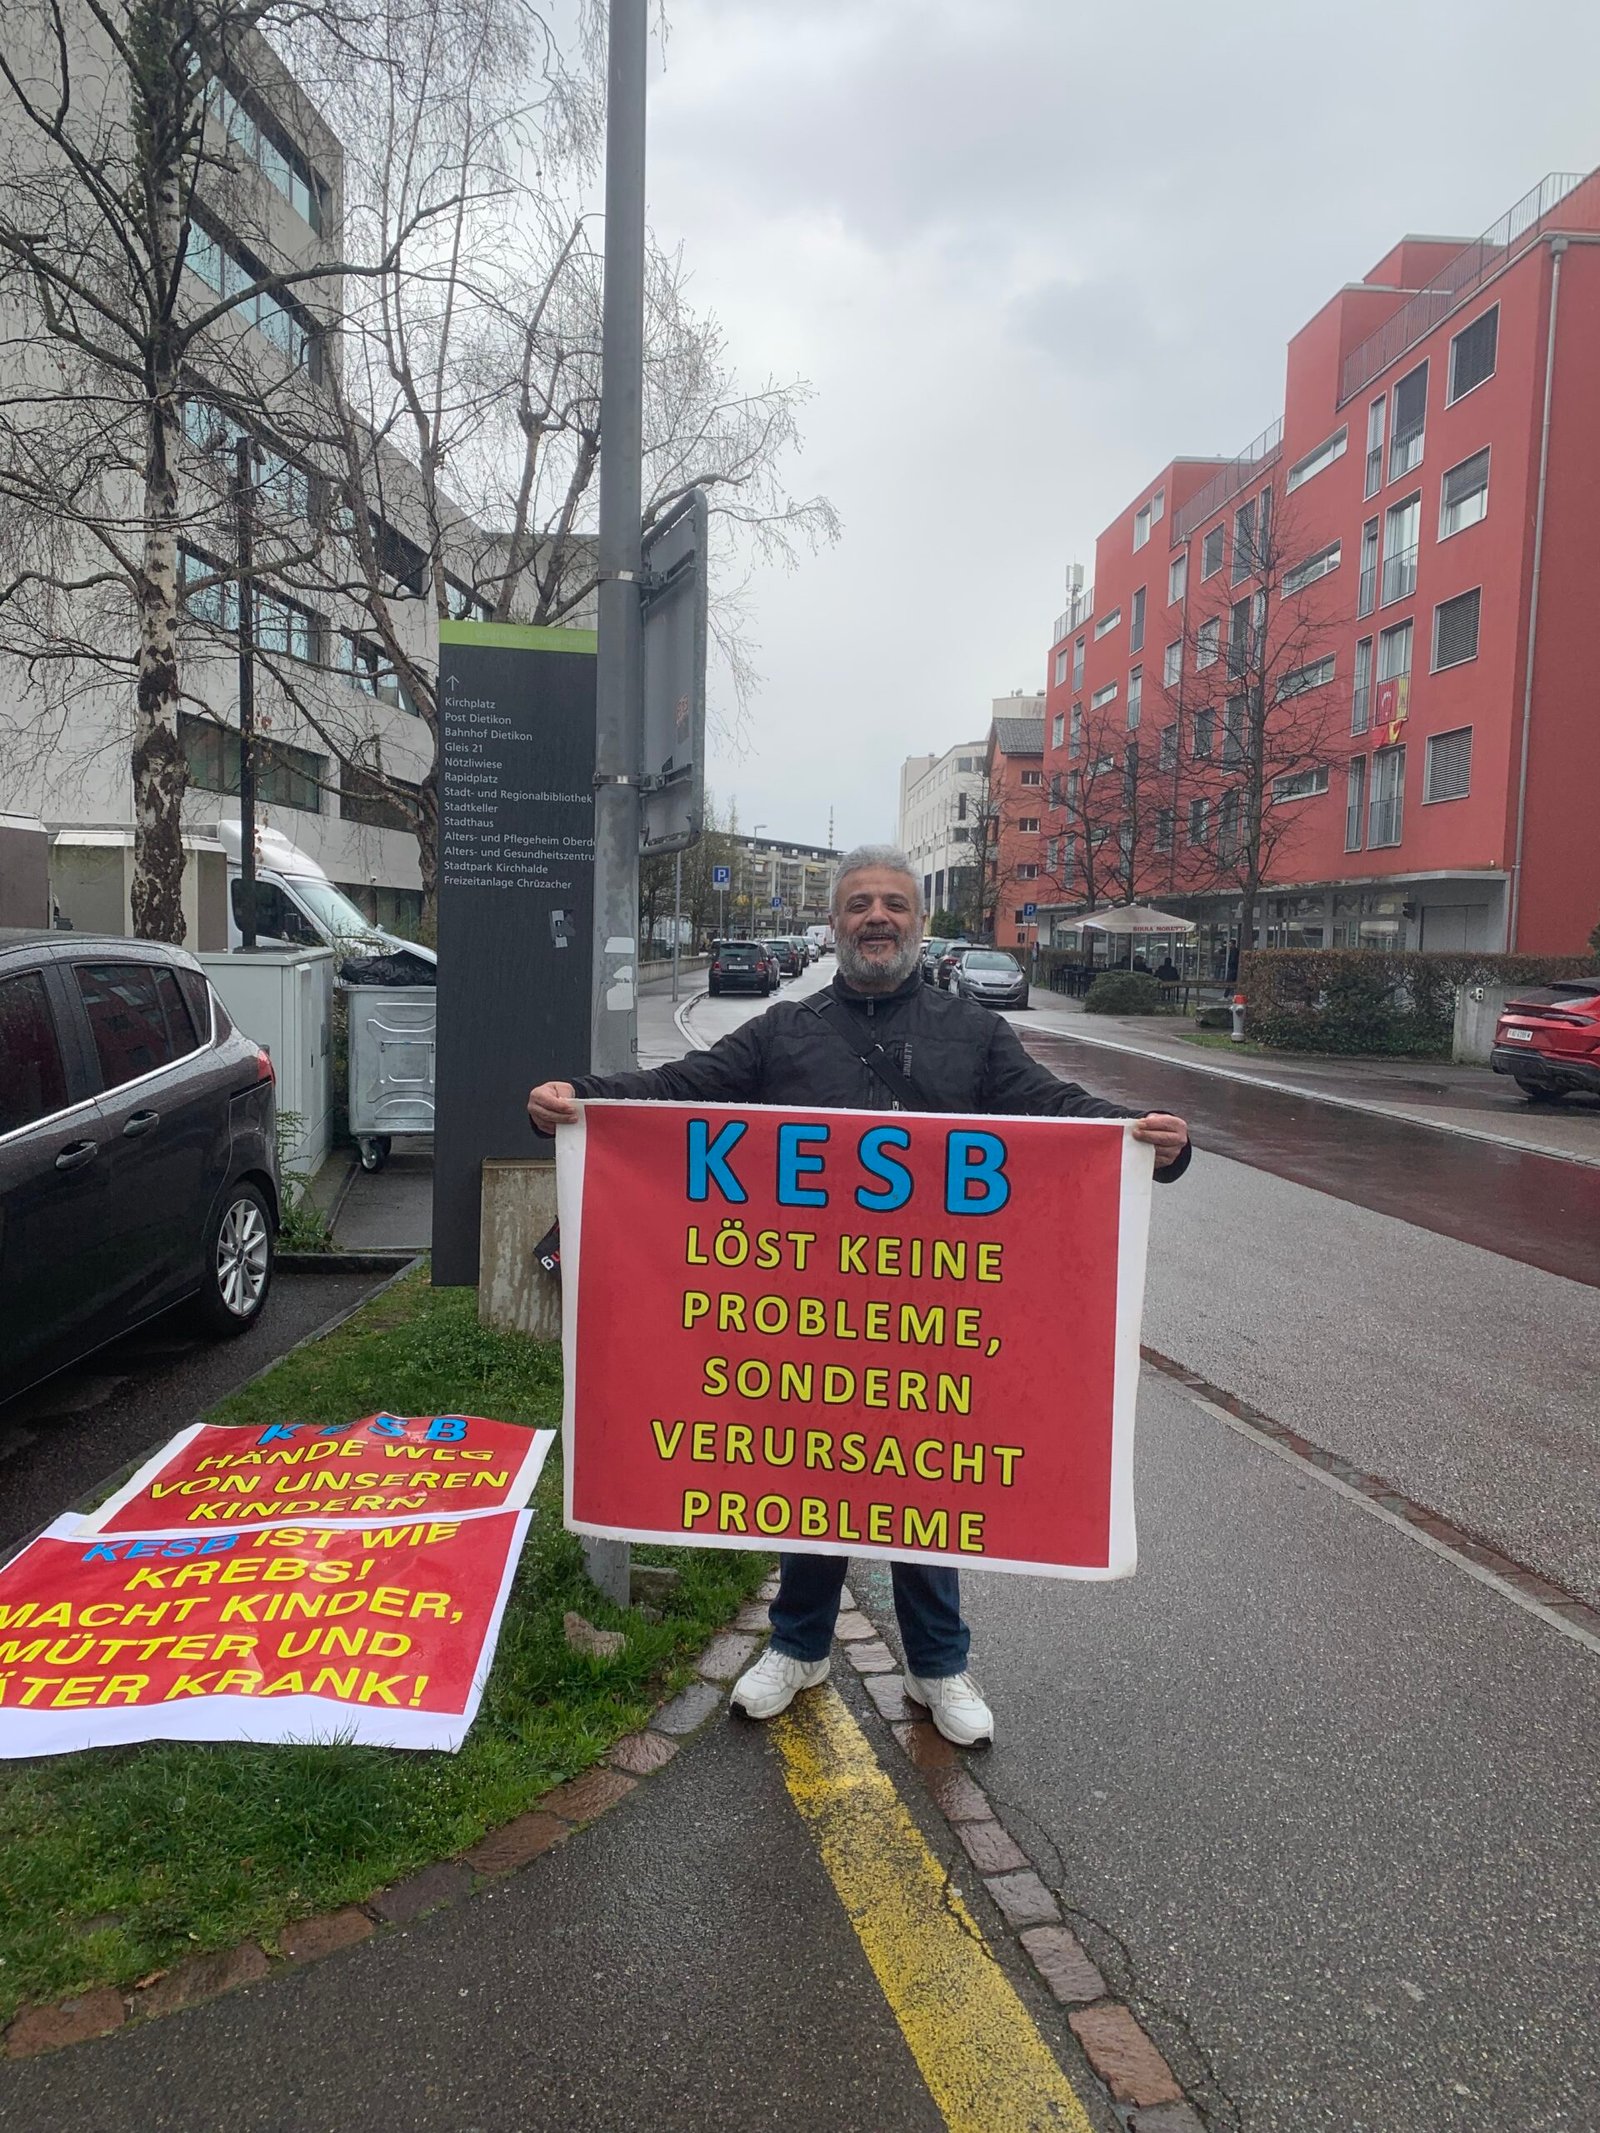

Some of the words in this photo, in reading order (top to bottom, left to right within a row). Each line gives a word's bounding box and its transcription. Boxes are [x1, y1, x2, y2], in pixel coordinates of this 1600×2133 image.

[444, 697, 496, 710] Kirchplatz
[444, 712, 466, 722] Post
[469, 713, 512, 725] Dietikon
[444, 727, 488, 739] Bahnhof
[491, 729, 533, 741] Dietikon
[444, 742, 469, 753] Gleis
[472, 744, 483, 753] 21
[444, 757, 503, 769] Nötzliwiese
[444, 772, 499, 785] Rapidplatz
[444, 787, 475, 797] Stadt-
[477, 789, 497, 798] und
[500, 790, 593, 804] Regionalbibliothek
[444, 802, 499, 813] Stadtkeller
[444, 817, 494, 828] Stadthaus
[444, 832, 478, 842] Alters-
[481, 834, 501, 843] und
[503, 834, 559, 846] Pflegeheim
[444, 846, 478, 856] Alters-
[480, 848, 500, 857] und
[503, 849, 595, 861] Gesundheitszentru
[444, 861, 493, 873] Stadtpark
[496, 863, 548, 874] Kirchhalde
[718, 869, 726, 882] P
[444, 875, 514, 888] Freizeitanlage
[685, 1218, 817, 1271] LÖST
[839, 1234, 1004, 1283] KEINE
[682, 1290, 1003, 1357] PROBLEME,
[702, 1356, 973, 1415] SONDERN
[195, 1440, 369, 1473] HÄNDE
[383, 1444, 495, 1462] WEG
[650, 1419, 1025, 1486] VERURSACHT
[150, 1472, 263, 1499] VON
[273, 1470, 510, 1495] UNSEREN
[187, 1495, 428, 1521] KINDERN
[681, 1489, 986, 1552] PROBLEME
[81, 1532, 241, 1563] KESB
[252, 1527, 346, 1550] IST
[361, 1521, 462, 1551] WIE
[124, 1557, 375, 1592] KREBS!
[0, 1597, 210, 1629] MACHT
[218, 1588, 465, 1625] KINDER,
[0, 1633, 269, 1666] MÜTTER
[277, 1626, 412, 1660] UND
[163, 1667, 431, 1708] KRANK!
